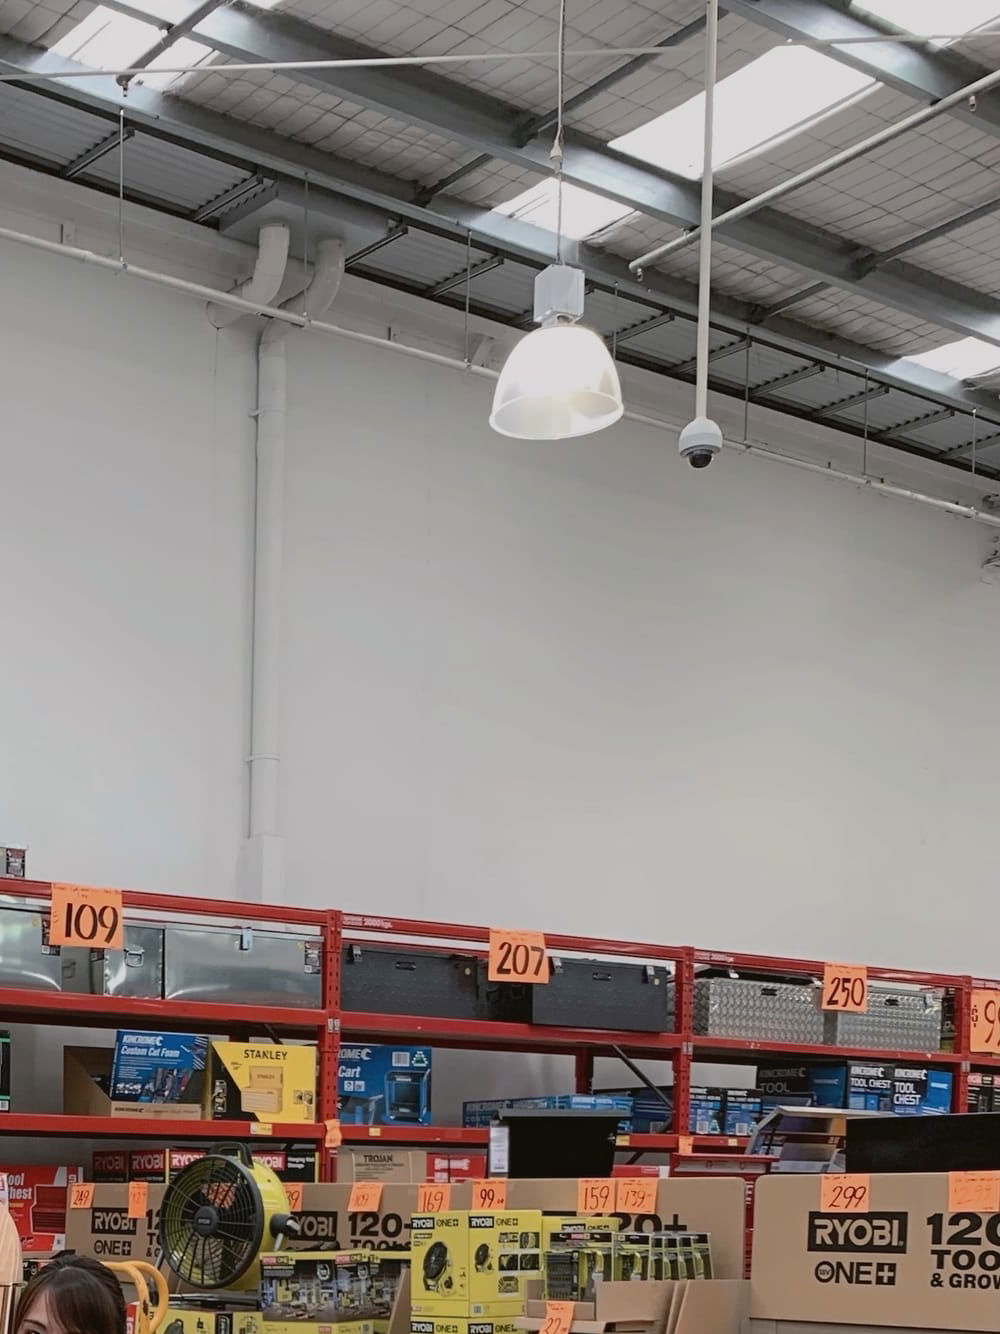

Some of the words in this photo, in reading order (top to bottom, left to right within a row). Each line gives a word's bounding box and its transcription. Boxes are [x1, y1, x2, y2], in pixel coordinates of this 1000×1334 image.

[65, 903, 118, 944] 109
[497, 942, 544, 976] 207
[827, 977, 866, 1008] 250
[148, 1047, 160, 1057] Cut
[161, 1048, 180, 1058] Foam
[244, 1049, 288, 1060] STANLEY
[338, 1065, 361, 1078] Cart
[760, 1082, 790, 1094] TOOL
[850, 1078, 868, 1087] TOOL
[869, 1079, 892, 1088] CHEST
[894, 1082, 916, 1093] TOOL
[893, 1094, 921, 1105] CHEST
[94, 1154, 125, 1169] RYOBI
[132, 1154, 164, 1168] RYOBI
[363, 1155, 393, 1163] TROJAN
[72, 1188, 90, 1207] 249
[423, 1191, 443, 1213] 169
[583, 1185, 610, 1210] 159
[829, 1185, 866, 1208] 299
[412, 1219, 434, 1228] RYOBI
[471, 1217, 493, 1227] RYOBI
[814, 1219, 903, 1246] RYOBI
[930, 1273, 944, 1288] &
[412, 1323, 433, 1333] RYOBI
[469, 1324, 492, 1334] RYOBI
